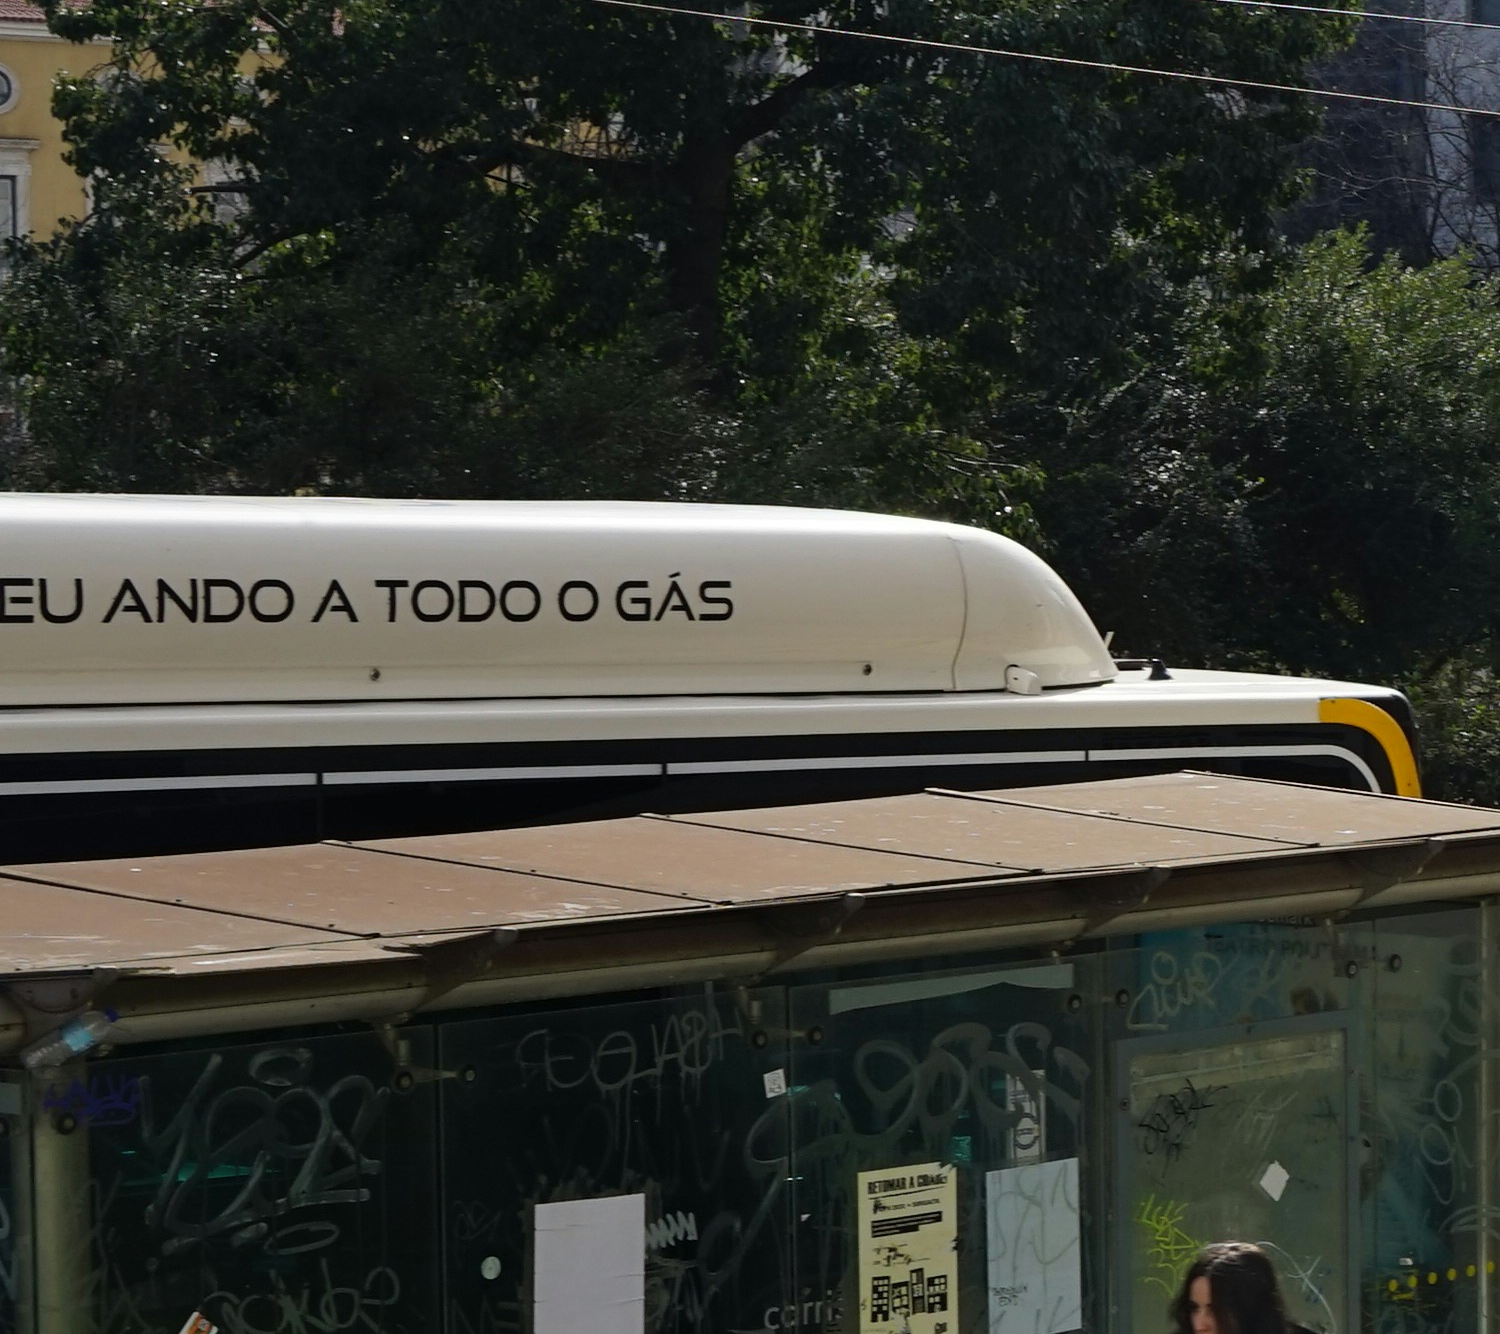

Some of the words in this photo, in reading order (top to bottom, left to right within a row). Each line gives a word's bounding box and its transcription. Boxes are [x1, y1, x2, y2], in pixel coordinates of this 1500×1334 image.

[0, 578, 83, 624] EU
[101, 578, 296, 624] ANDO
[312, 579, 359, 623] A
[375, 579, 542, 623] TODO
[557, 580, 601, 623] O
[615, 571, 735, 622] GÁS
